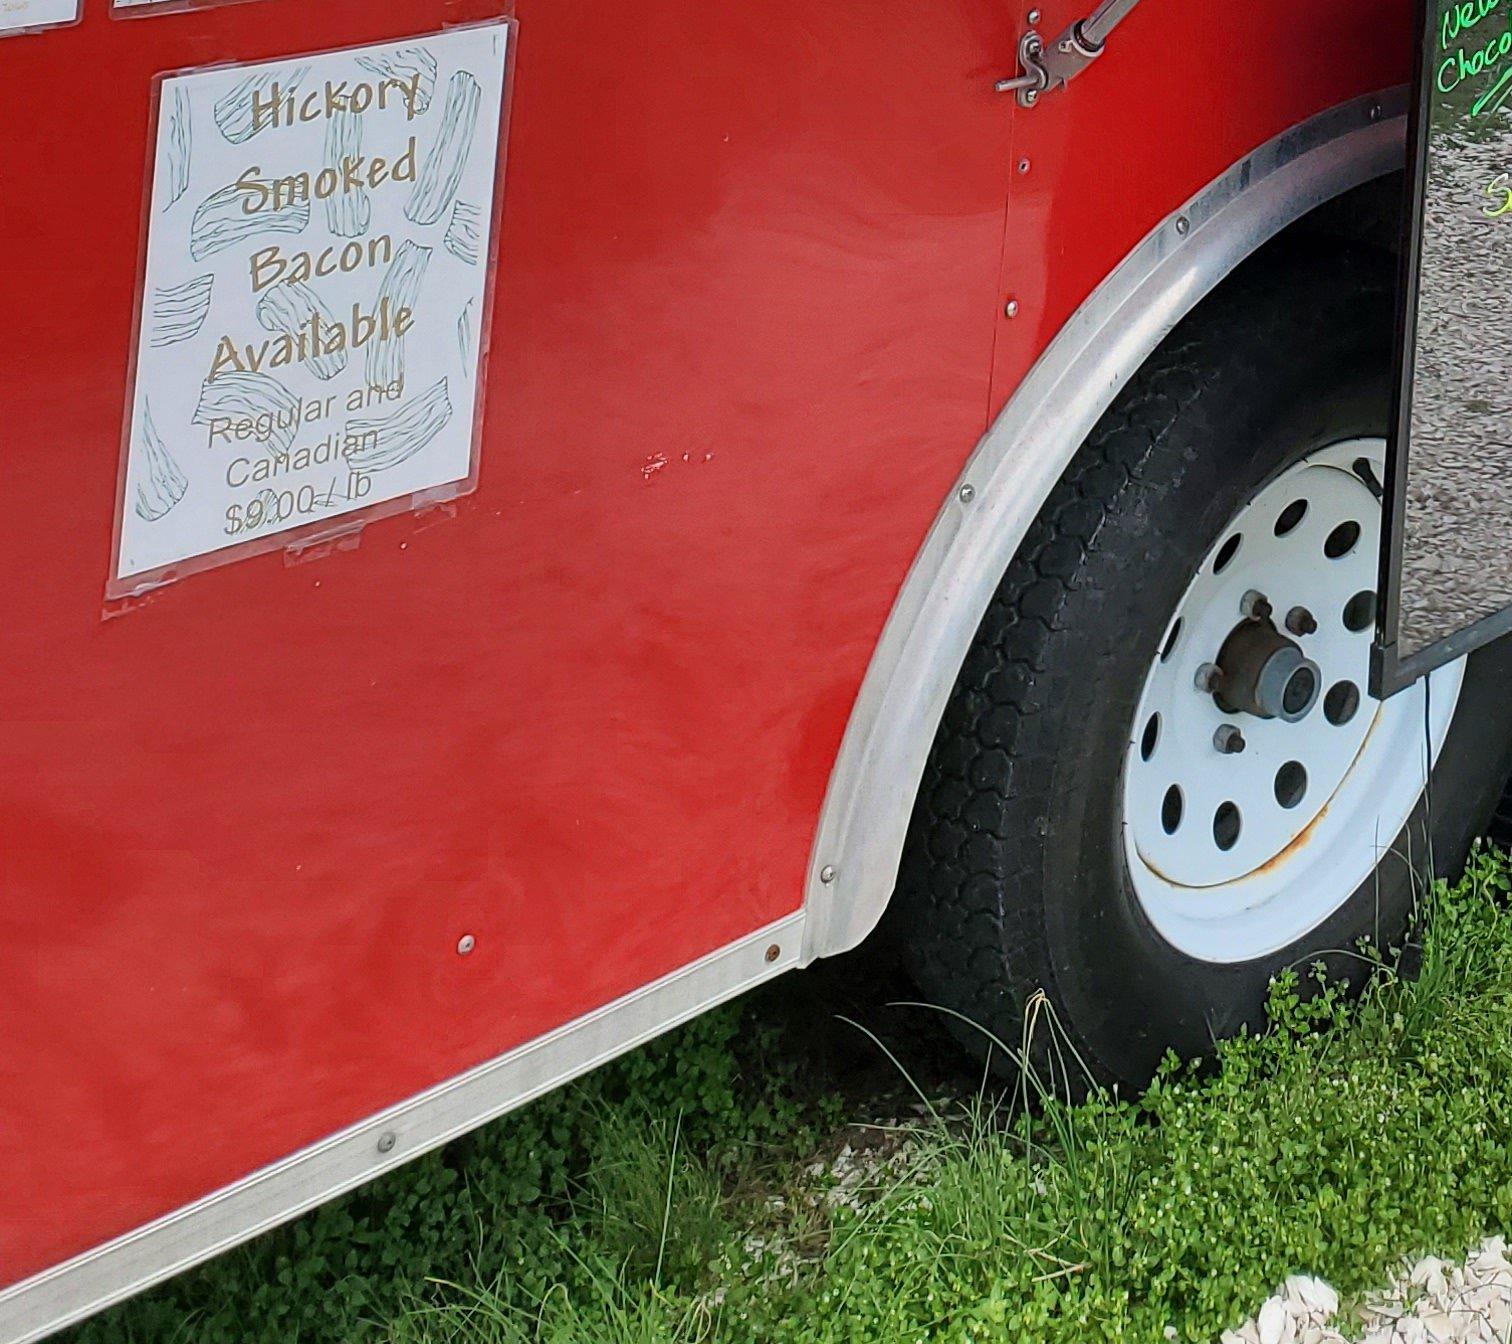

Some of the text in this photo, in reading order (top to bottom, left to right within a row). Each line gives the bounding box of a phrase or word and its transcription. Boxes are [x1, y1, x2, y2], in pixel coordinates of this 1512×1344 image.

[249, 72, 424, 133] Hickory
[233, 135, 418, 216] Smoked
[248, 232, 393, 294] Bacon
[206, 296, 417, 383] Available
[206, 379, 406, 449] Regular and
[226, 426, 379, 489] Canadian
[224, 484, 316, 537] $9.00
[347, 469, 373, 501] lb
